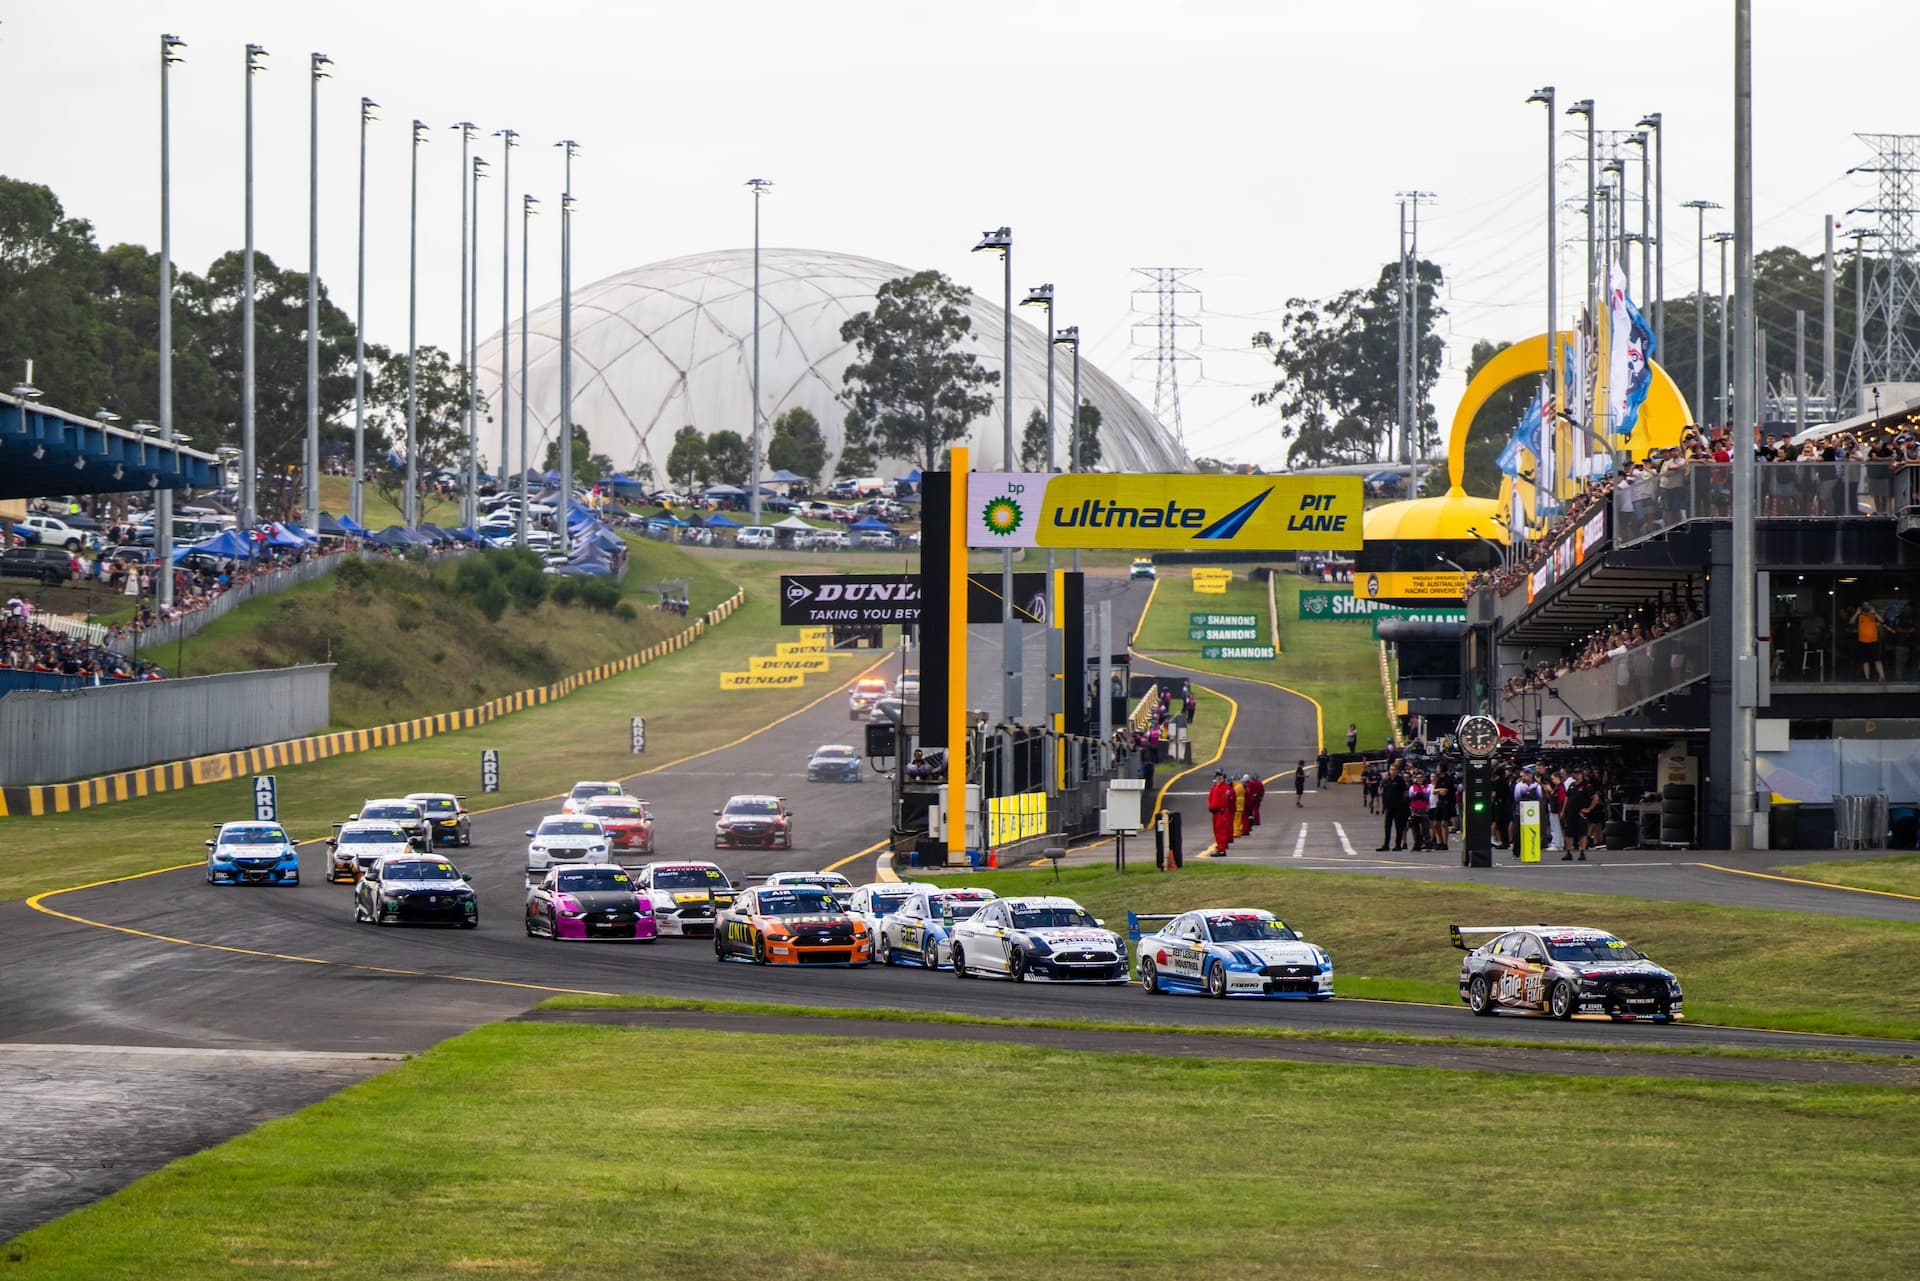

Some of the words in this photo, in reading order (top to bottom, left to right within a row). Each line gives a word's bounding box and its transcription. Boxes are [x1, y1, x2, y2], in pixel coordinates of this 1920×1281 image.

[1008, 482, 1025, 495] bp
[1300, 495, 1336, 511] PIT
[1054, 500, 1206, 528] ultimate
[1288, 516, 1347, 532] LANE
[814, 583, 921, 602] DUNL
[809, 609, 858, 620] TAKING
[863, 608, 891, 619] YOU
[895, 608, 921, 619] BEY
[1207, 615, 1256, 626] SHANNONS
[1206, 629, 1257, 639] SHANNONS
[1221, 647, 1274, 658] SHANNONS
[761, 660, 823, 669] DUNLOP
[733, 675, 799, 684] DUNLOP
[728, 921, 749, 943] UNIT
[1499, 969, 1522, 999] dare
